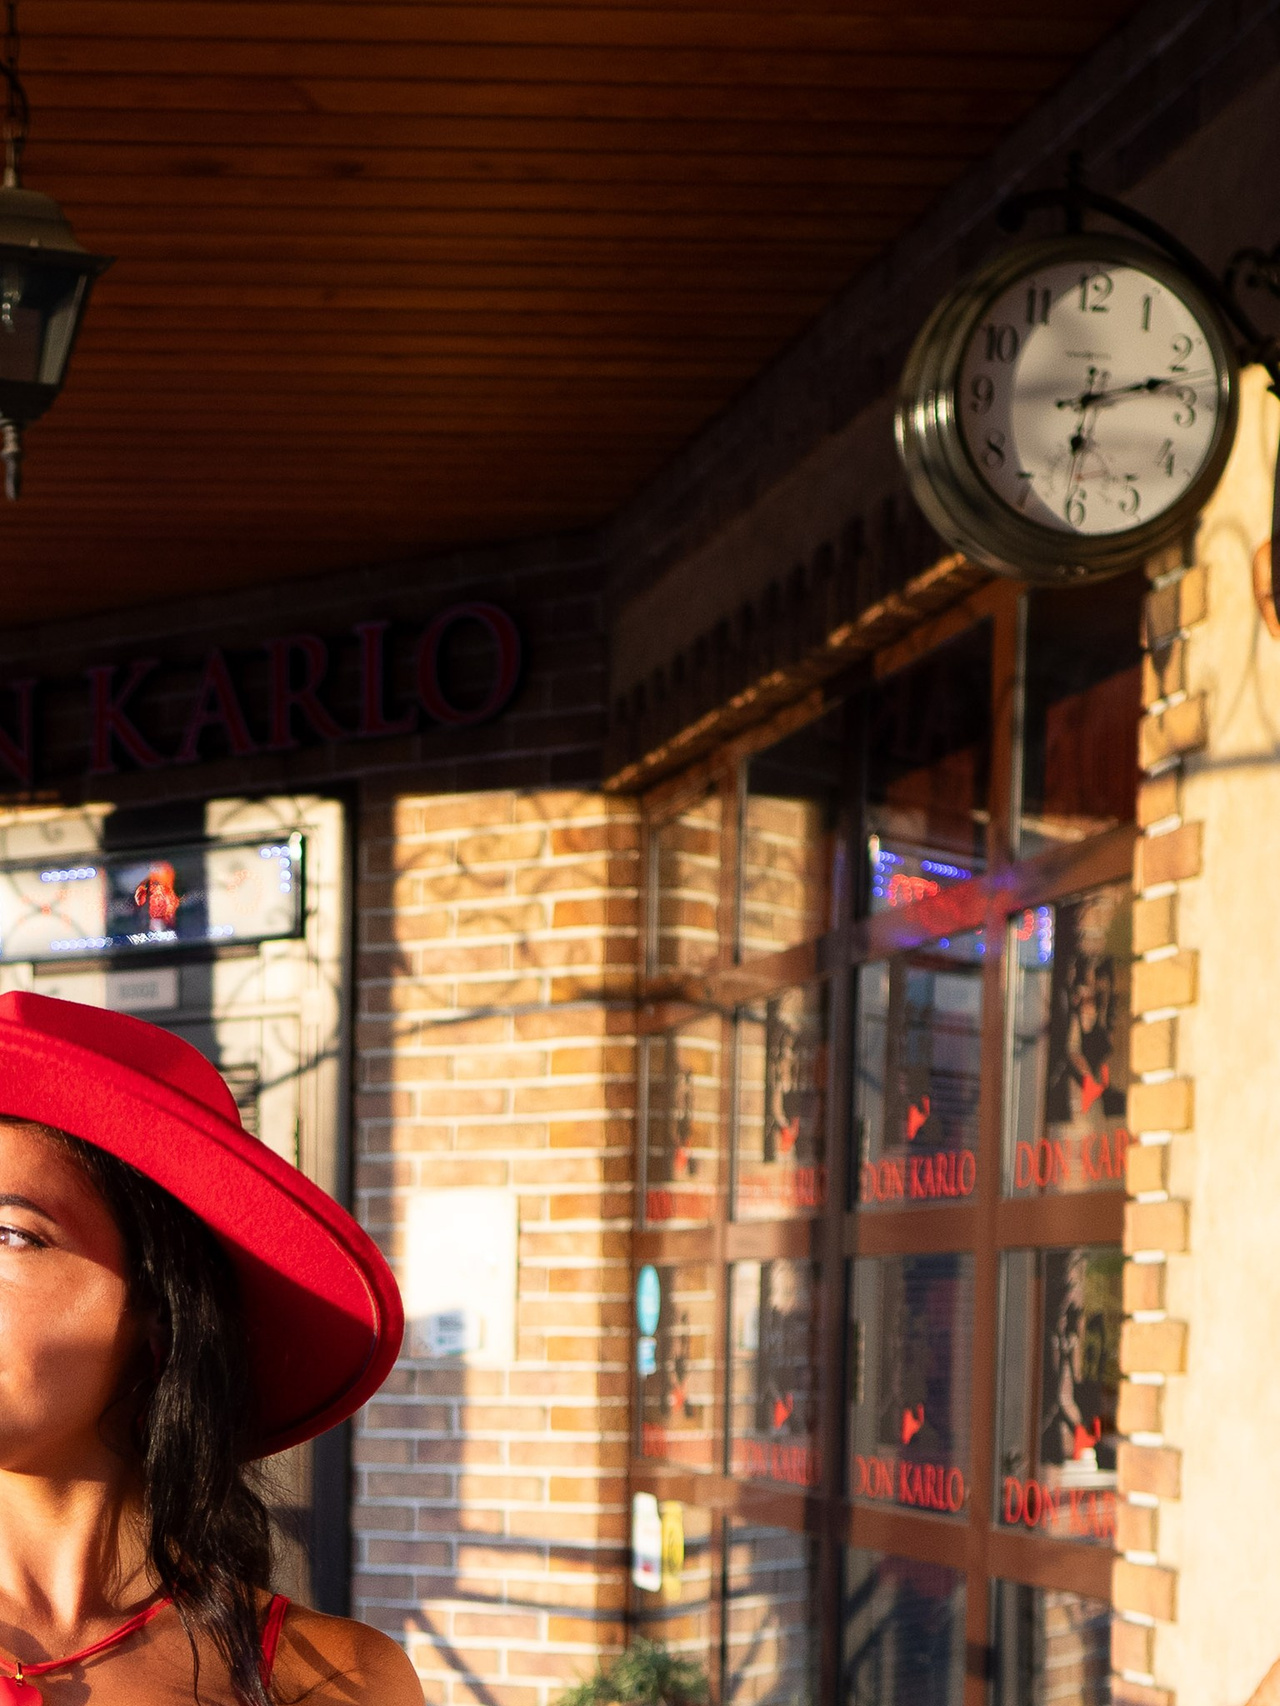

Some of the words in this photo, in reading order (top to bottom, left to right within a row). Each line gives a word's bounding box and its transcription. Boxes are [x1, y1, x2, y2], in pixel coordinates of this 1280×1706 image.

[1025, 286, 1052, 327] 11
[1078, 272, 1114, 313] 12
[1141, 294, 1153, 333] 1
[984, 323, 1020, 363] 10
[1169, 333, 1194, 373] 2
[971, 375, 995, 414] 9
[1173, 385, 1198, 428] 3
[984, 429, 1006, 470] 8
[1064, 483, 1088, 527] 6
[1119, 473, 1141, 516] 5
[86, 601, 522, 775] KARLO
[860, 1158, 905, 1203] DON
[909, 1149, 976, 1199] KARLO
[1015, 1137, 1070, 1190] DON
[1080, 1127, 1130, 1183] KAR
[899, 1460, 964, 1513] KARLO
[1004, 1475, 1060, 1527] DON
[1068, 1487, 1117, 1539] KAR
